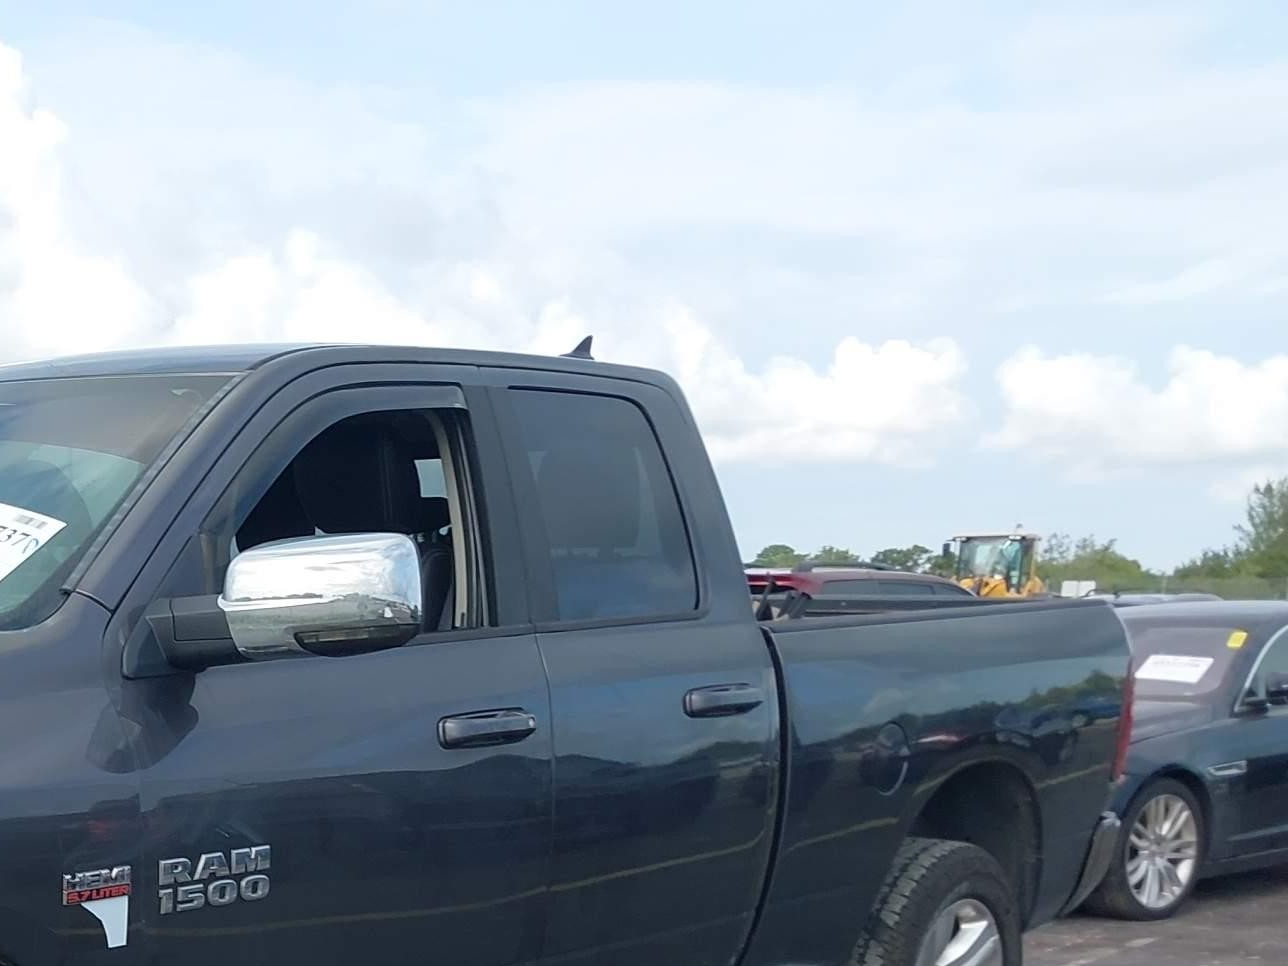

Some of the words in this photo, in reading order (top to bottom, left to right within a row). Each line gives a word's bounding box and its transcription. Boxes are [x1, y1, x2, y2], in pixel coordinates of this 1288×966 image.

[62, 865, 131, 891] HEMI
[158, 845, 271, 885] RAM
[67, 890, 91, 904] 5.7
[92, 884, 129, 899] LITER
[158, 874, 271, 914] 1500
